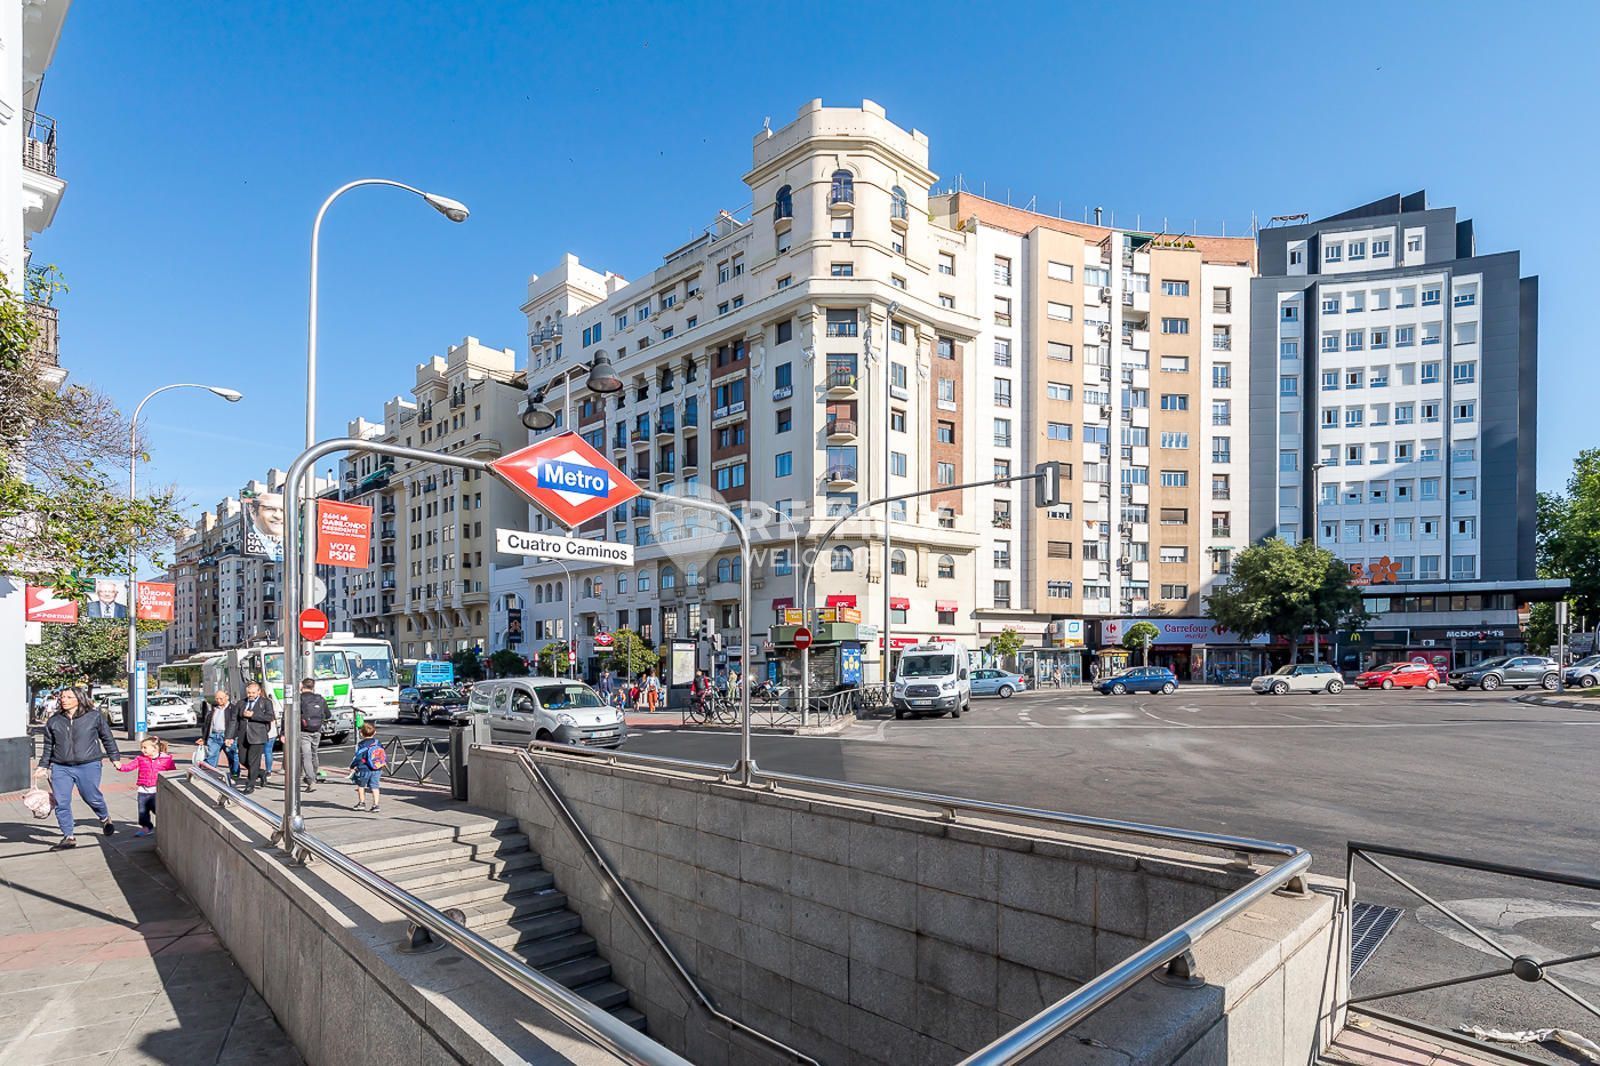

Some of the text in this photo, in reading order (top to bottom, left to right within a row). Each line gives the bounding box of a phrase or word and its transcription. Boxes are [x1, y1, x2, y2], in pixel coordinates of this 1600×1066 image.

[545, 463, 605, 491] Metro
[322, 519, 367, 530] GABILONDO
[329, 542, 357, 552] VOTA
[507, 534, 628, 561] Cuatro Caminos
[329, 550, 357, 562] PSOE
[1164, 623, 1208, 633] Carrefour
